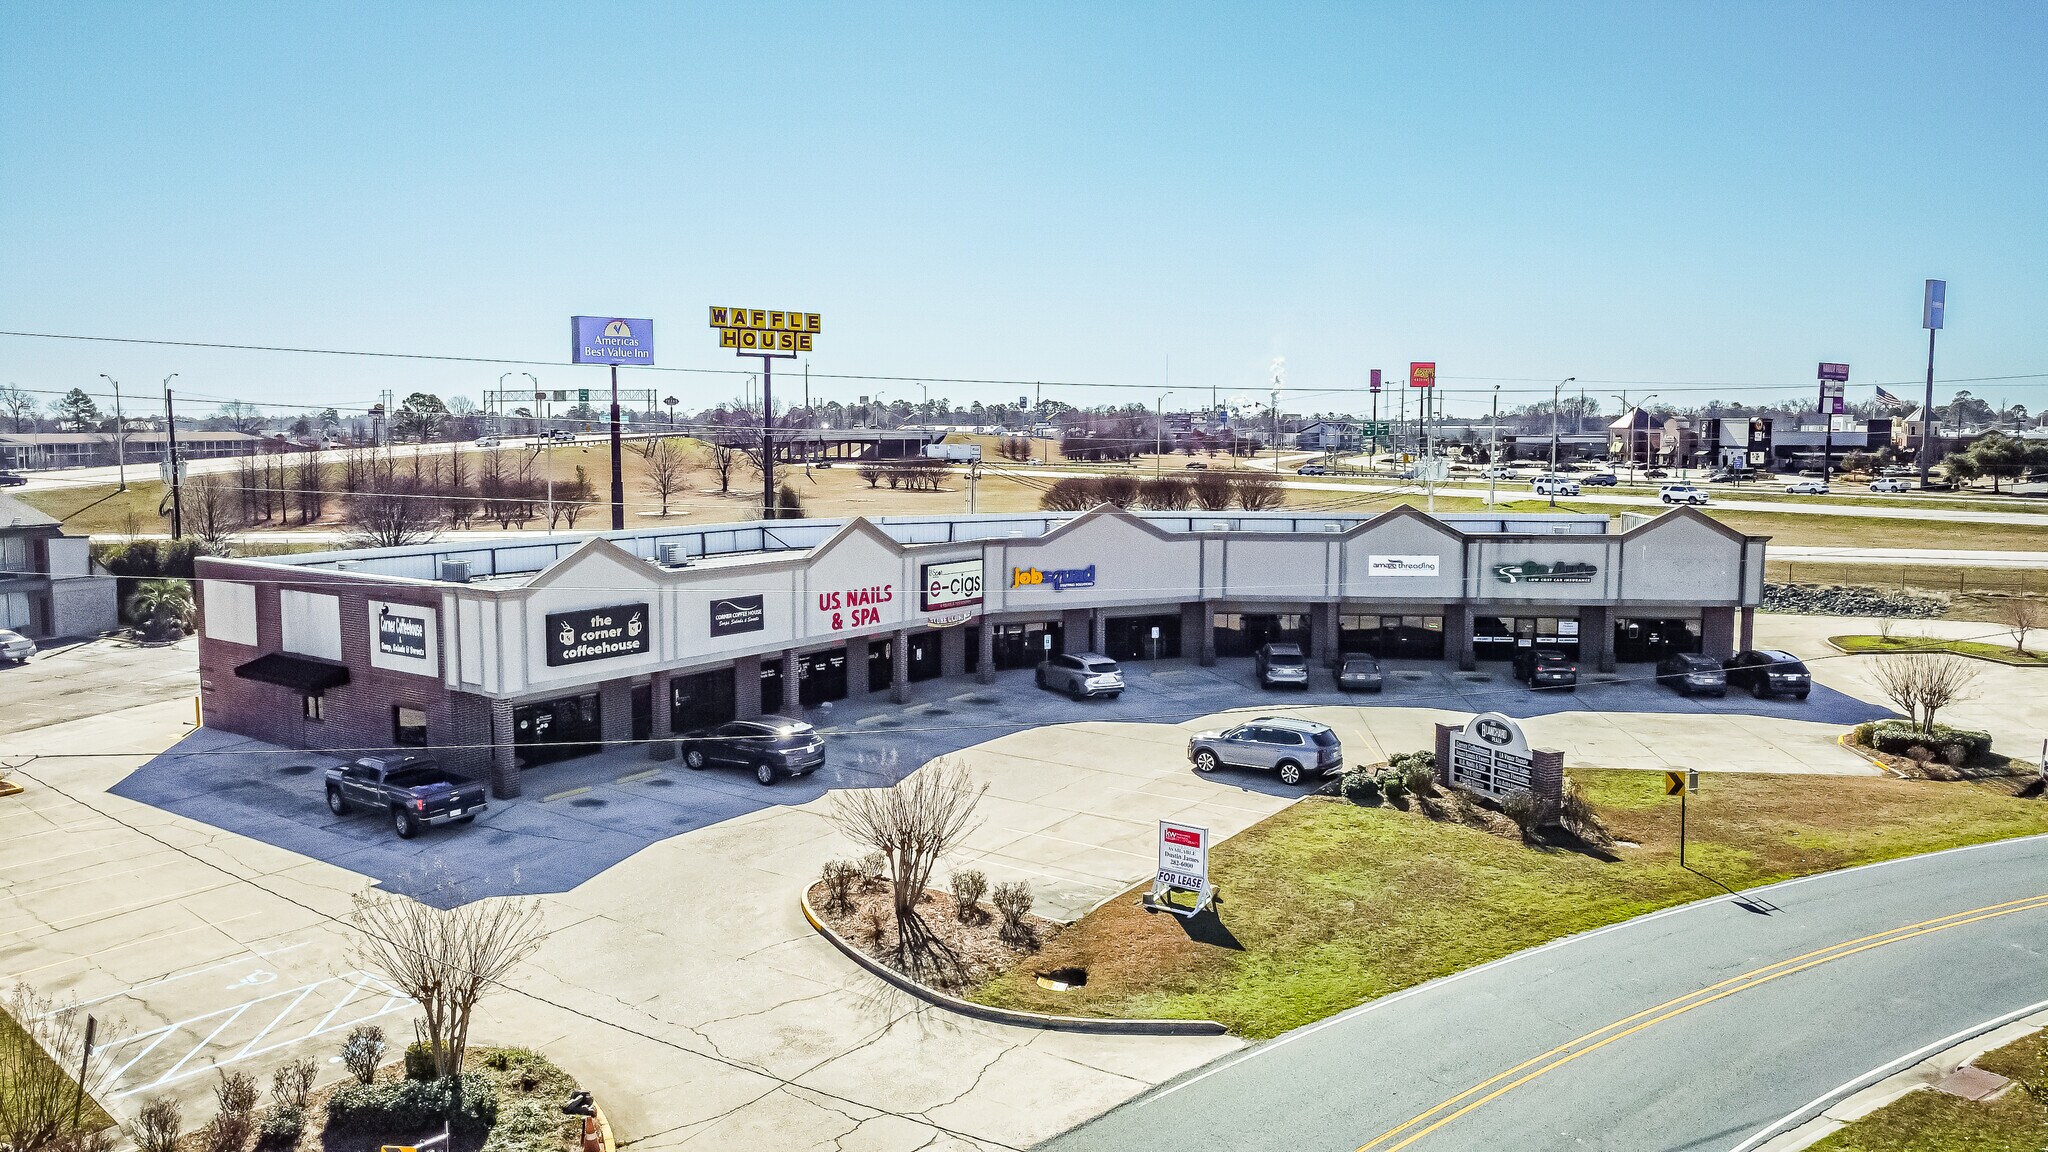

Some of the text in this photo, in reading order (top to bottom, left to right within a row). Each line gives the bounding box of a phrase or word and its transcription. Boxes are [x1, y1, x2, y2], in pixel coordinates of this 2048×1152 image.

[713, 309, 818, 328] WAFFLE
[594, 336, 639, 346] Americas
[724, 332, 810, 348] HOUSE
[585, 347, 648, 358] Best Value Inn
[931, 574, 980, 597] e-cigs
[847, 585, 892, 607] NAILS
[381, 615, 422, 637] Corner Coffeehouse
[591, 615, 612, 628] the
[832, 607, 880, 630] & SPA
[581, 628, 622, 641] corner
[563, 640, 640, 659] coffeehouse
[1482, 723, 1507, 739] BLANCHARD
[1165, 851, 1181, 860] Dustin
[1159, 872, 1201, 888] FOR LEASE
